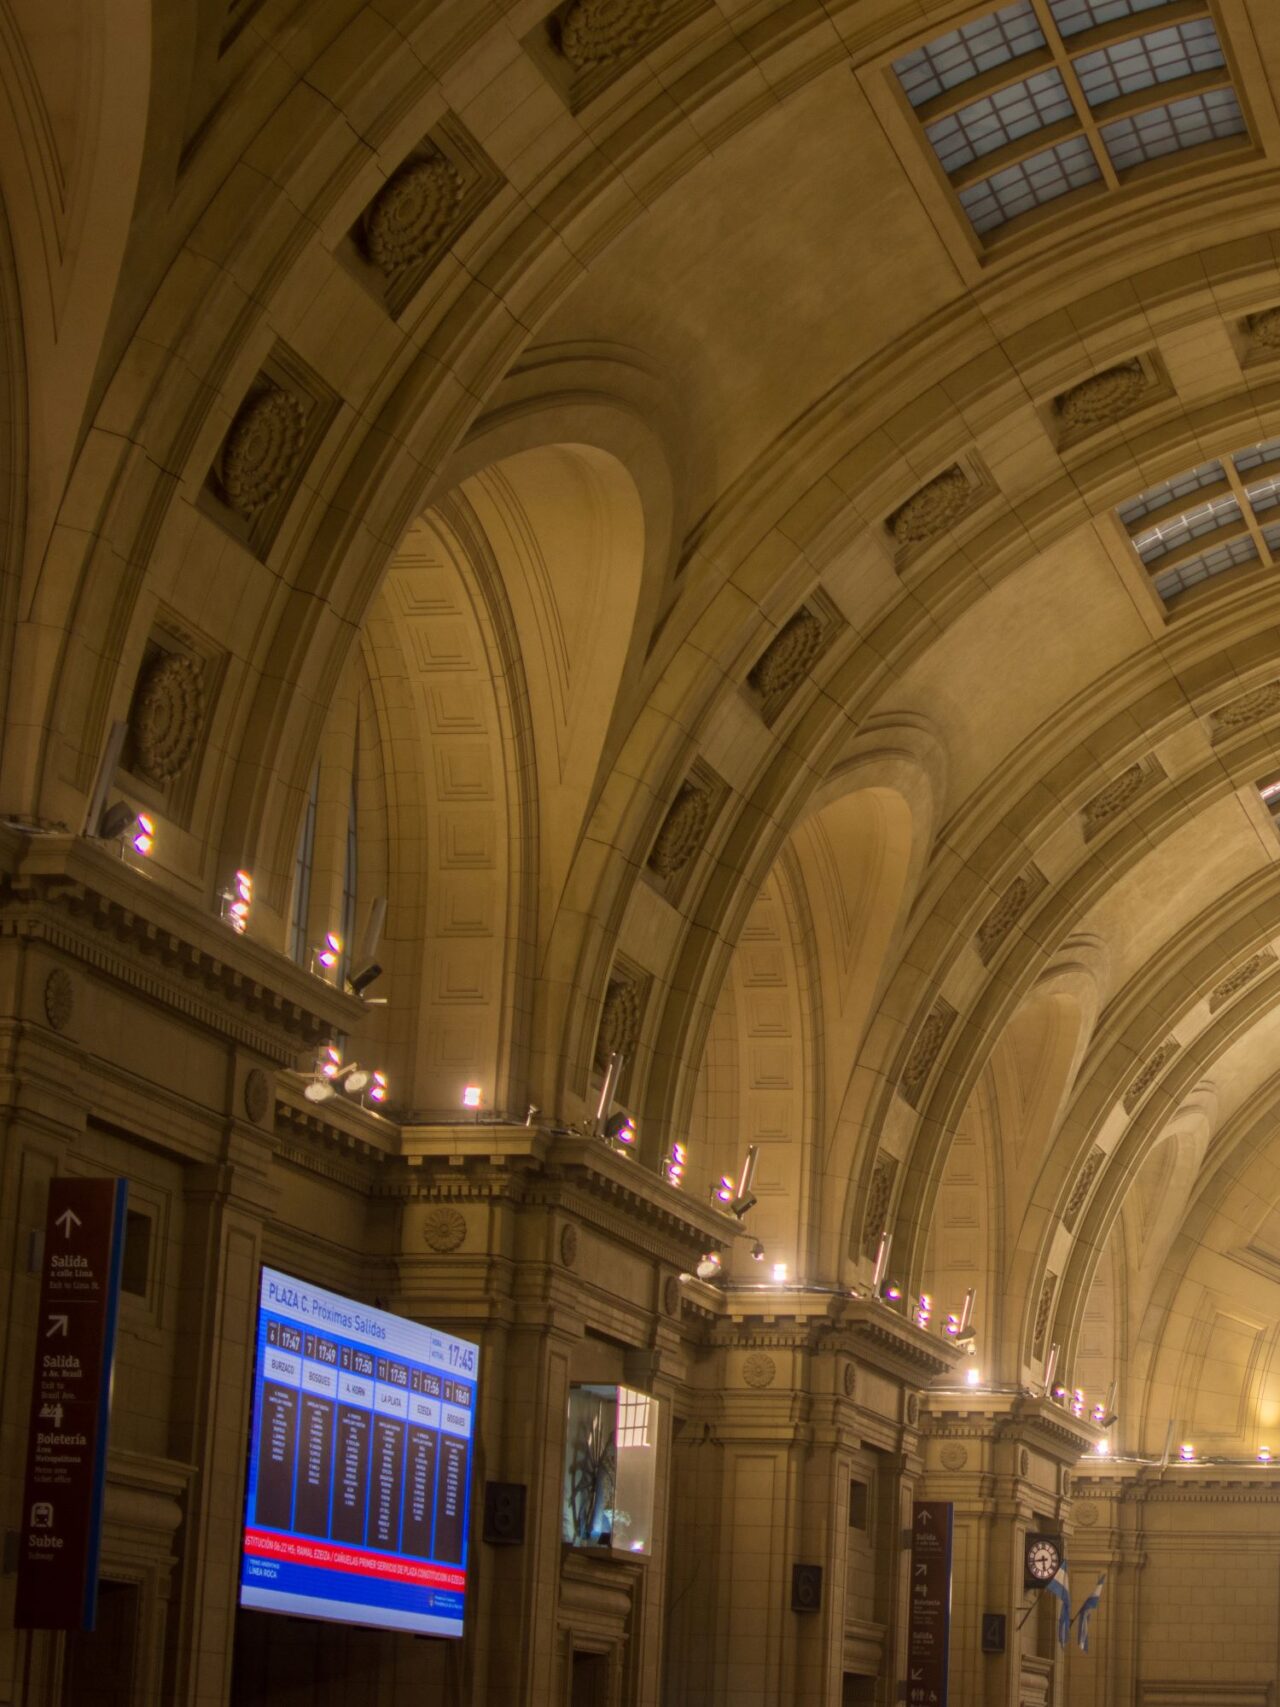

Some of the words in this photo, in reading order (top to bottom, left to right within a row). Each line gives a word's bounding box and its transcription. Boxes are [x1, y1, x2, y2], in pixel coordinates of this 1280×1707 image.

[51, 1254, 88, 1268] Salida
[269, 1282, 299, 1310] PLAZA
[302, 1295, 309, 1313] C.
[312, 1299, 352, 1329] Próximas
[354, 1314, 386, 1340] Salidas
[282, 1332, 301, 1352] 17:47
[43, 1354, 80, 1368] Salida
[448, 1343, 474, 1372] 17:45
[37, 1432, 87, 1445] Boletería
[28, 1534, 64, 1549] Subte
